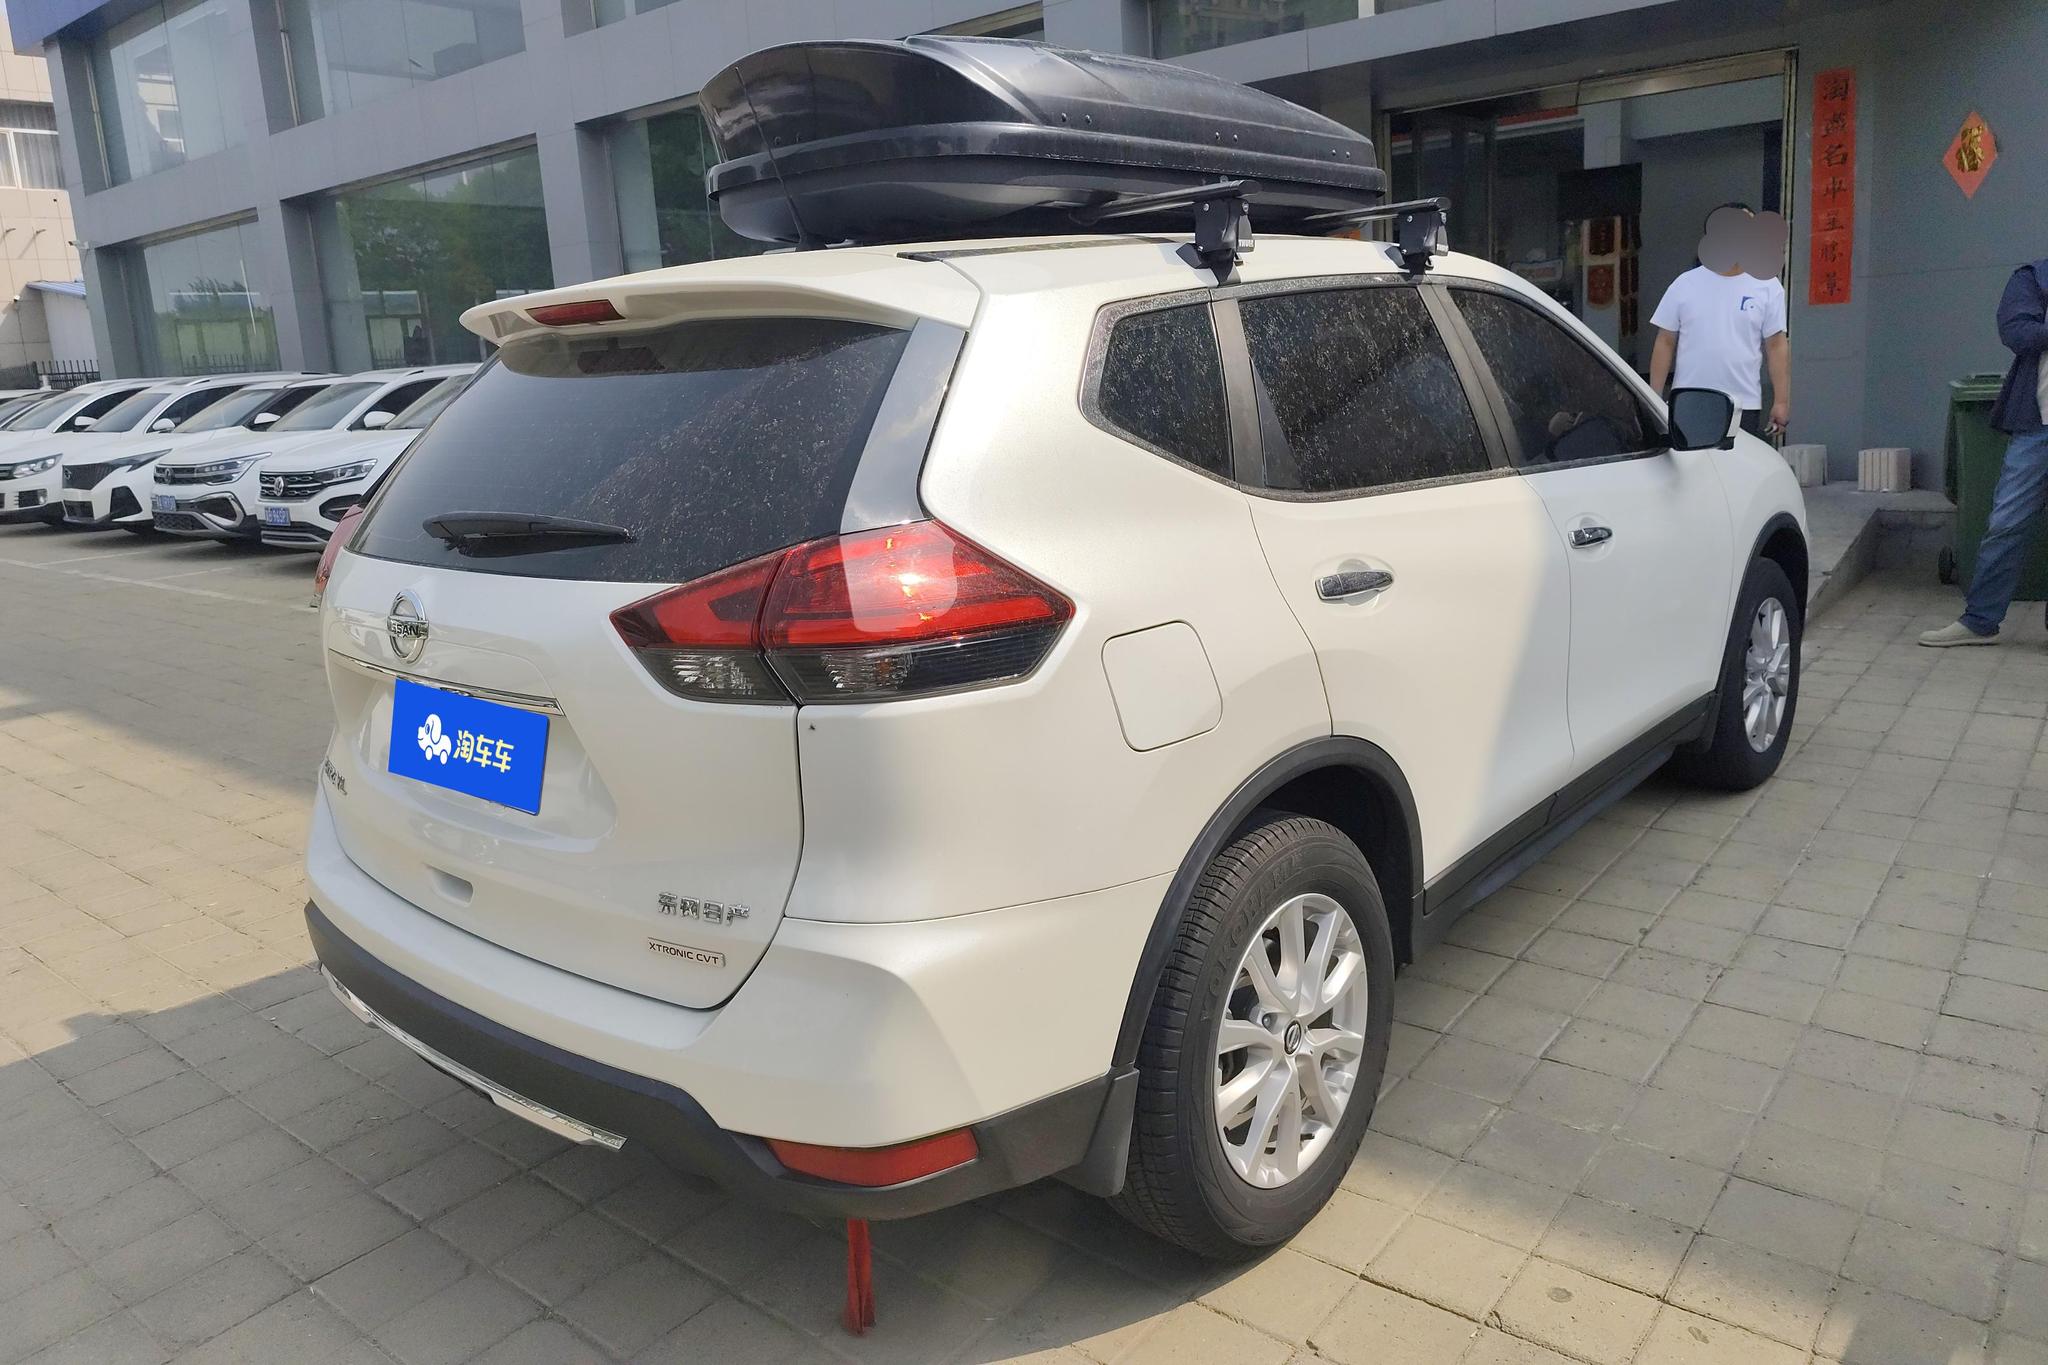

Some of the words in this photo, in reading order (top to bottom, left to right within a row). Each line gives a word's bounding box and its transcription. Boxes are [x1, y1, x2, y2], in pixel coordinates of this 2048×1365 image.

[658, 892, 750, 927] 东风日产
[649, 941, 694, 960] XTRONIC
[696, 953, 719, 965] CVT
